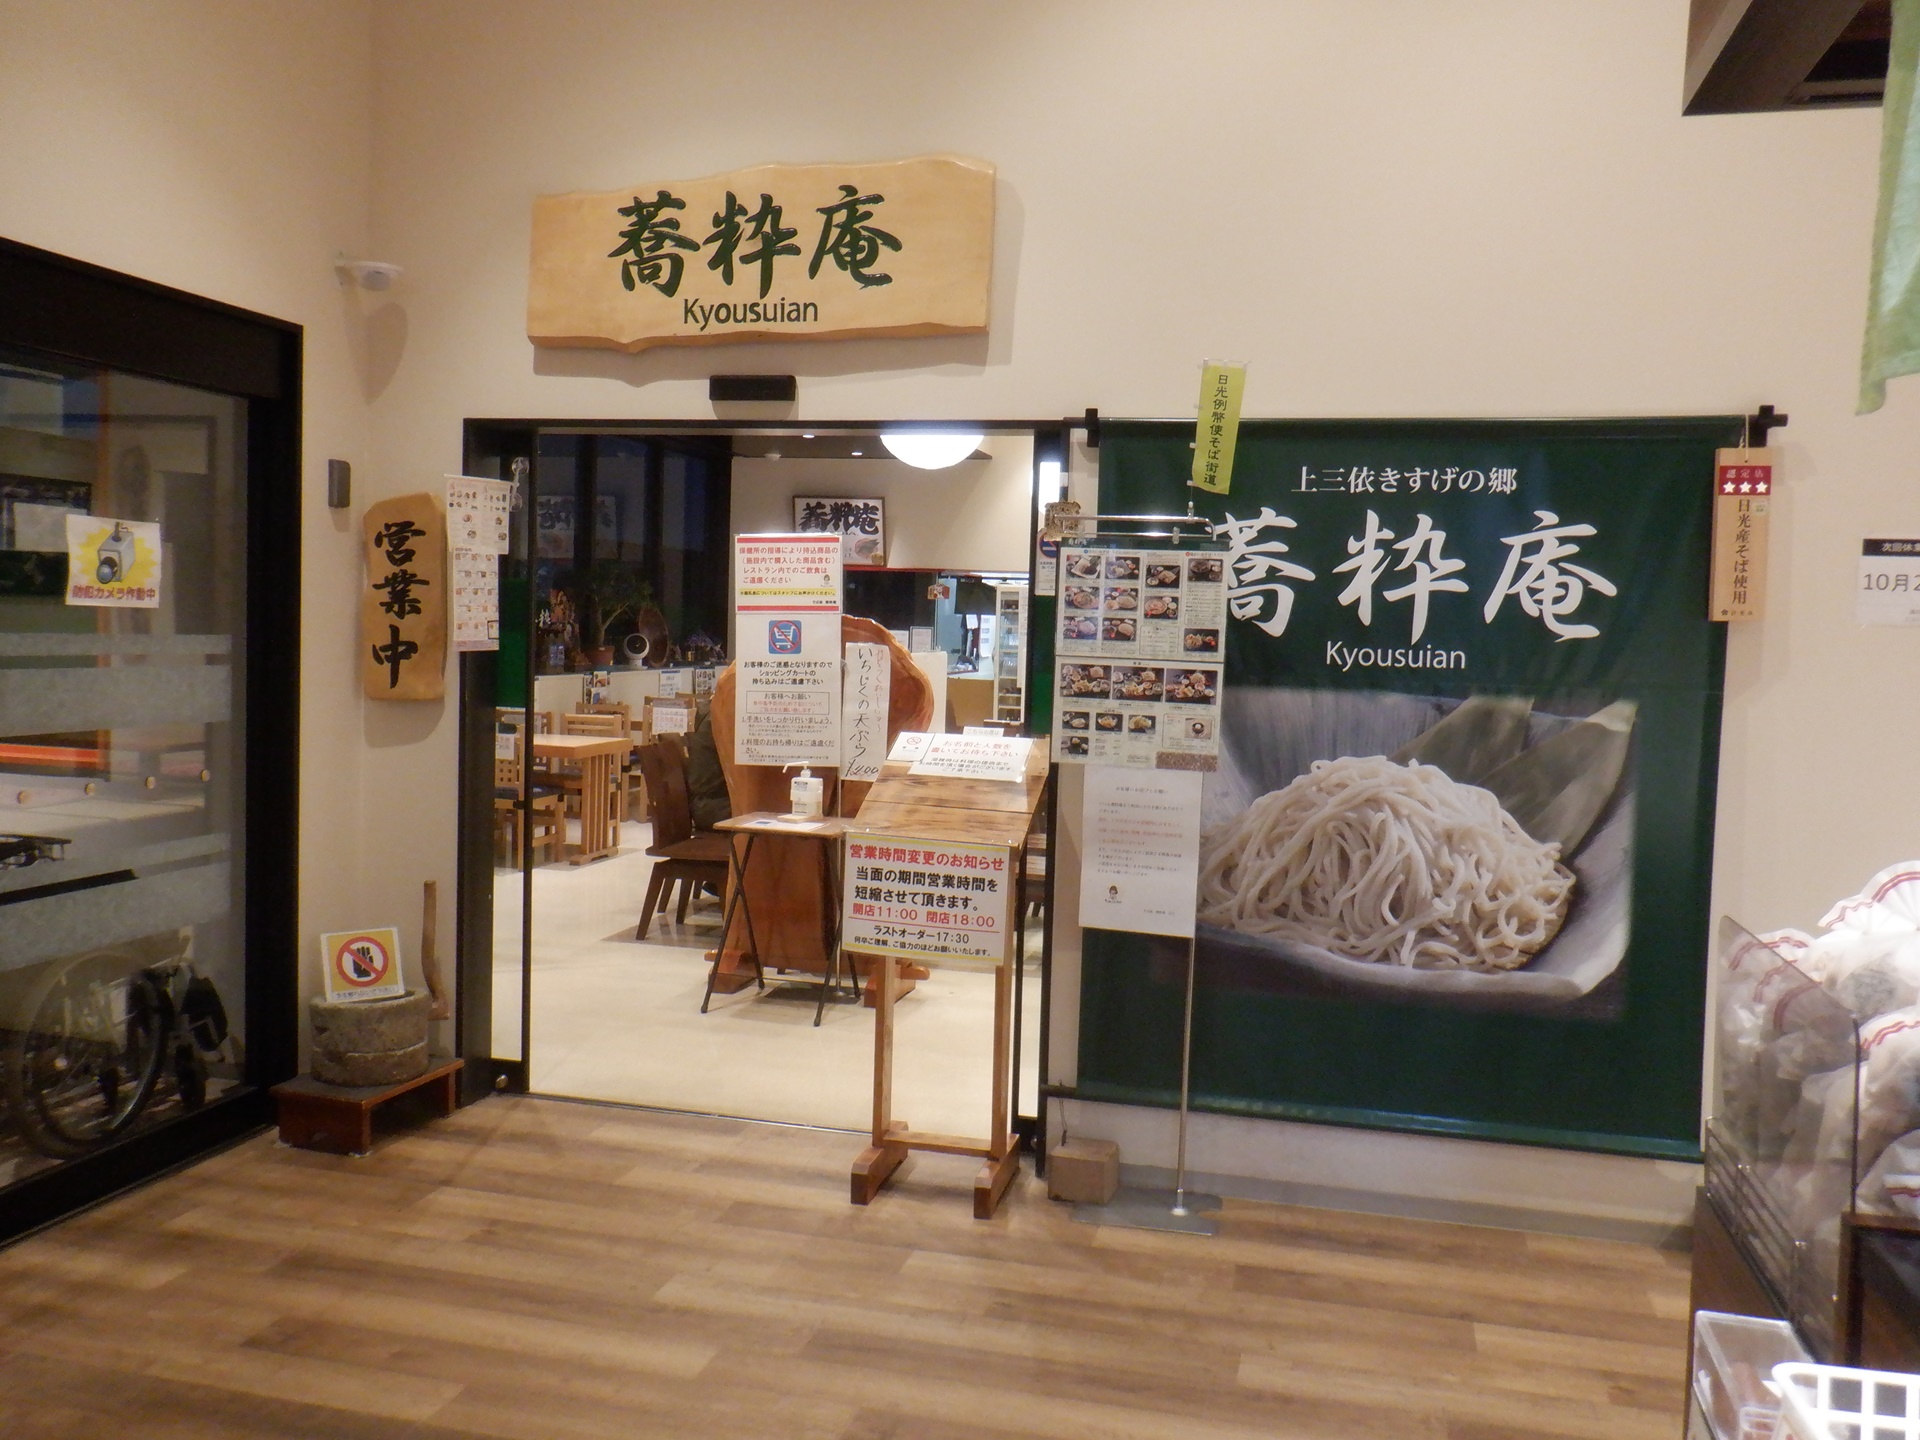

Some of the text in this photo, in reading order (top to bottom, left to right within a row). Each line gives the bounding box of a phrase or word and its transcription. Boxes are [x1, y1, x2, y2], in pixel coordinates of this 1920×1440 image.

[607, 184, 902, 299] 蕎粋庵
[683, 297, 818, 331] Kyousuian
[1291, 466, 1517, 495] 上三依きすげの郷
[1731, 498, 1752, 605] 日光産そば使用
[742, 576, 792, 584] ご遠慮ください
[743, 566, 828, 574] レストラン内でのご飲食は
[1208, 507, 1617, 644] 蕎粋庵
[72, 584, 156, 601] 防犯カメラ作動中
[372, 520, 430, 689] 営業中
[743, 661, 833, 669] お客様のご迷惑となりますので
[1326, 640, 1467, 672] Kyousuian
[752, 678, 824, 686] 持ち込みはご遠慮下さい
[931, 746, 1020, 758] 書いてお待ち下さい
[942, 740, 1013, 750] お名前と人数を
[849, 844, 1005, 871] 営業時間変更のお知らせ
[856, 866, 998, 893] 当面の期間営業時間を
[854, 885, 979, 912] 短縮させて頂きます。
[852, 902, 996, 928] 開店11:00 閉店18:00
[873, 924, 970, 944] ラストオーダー17:30
